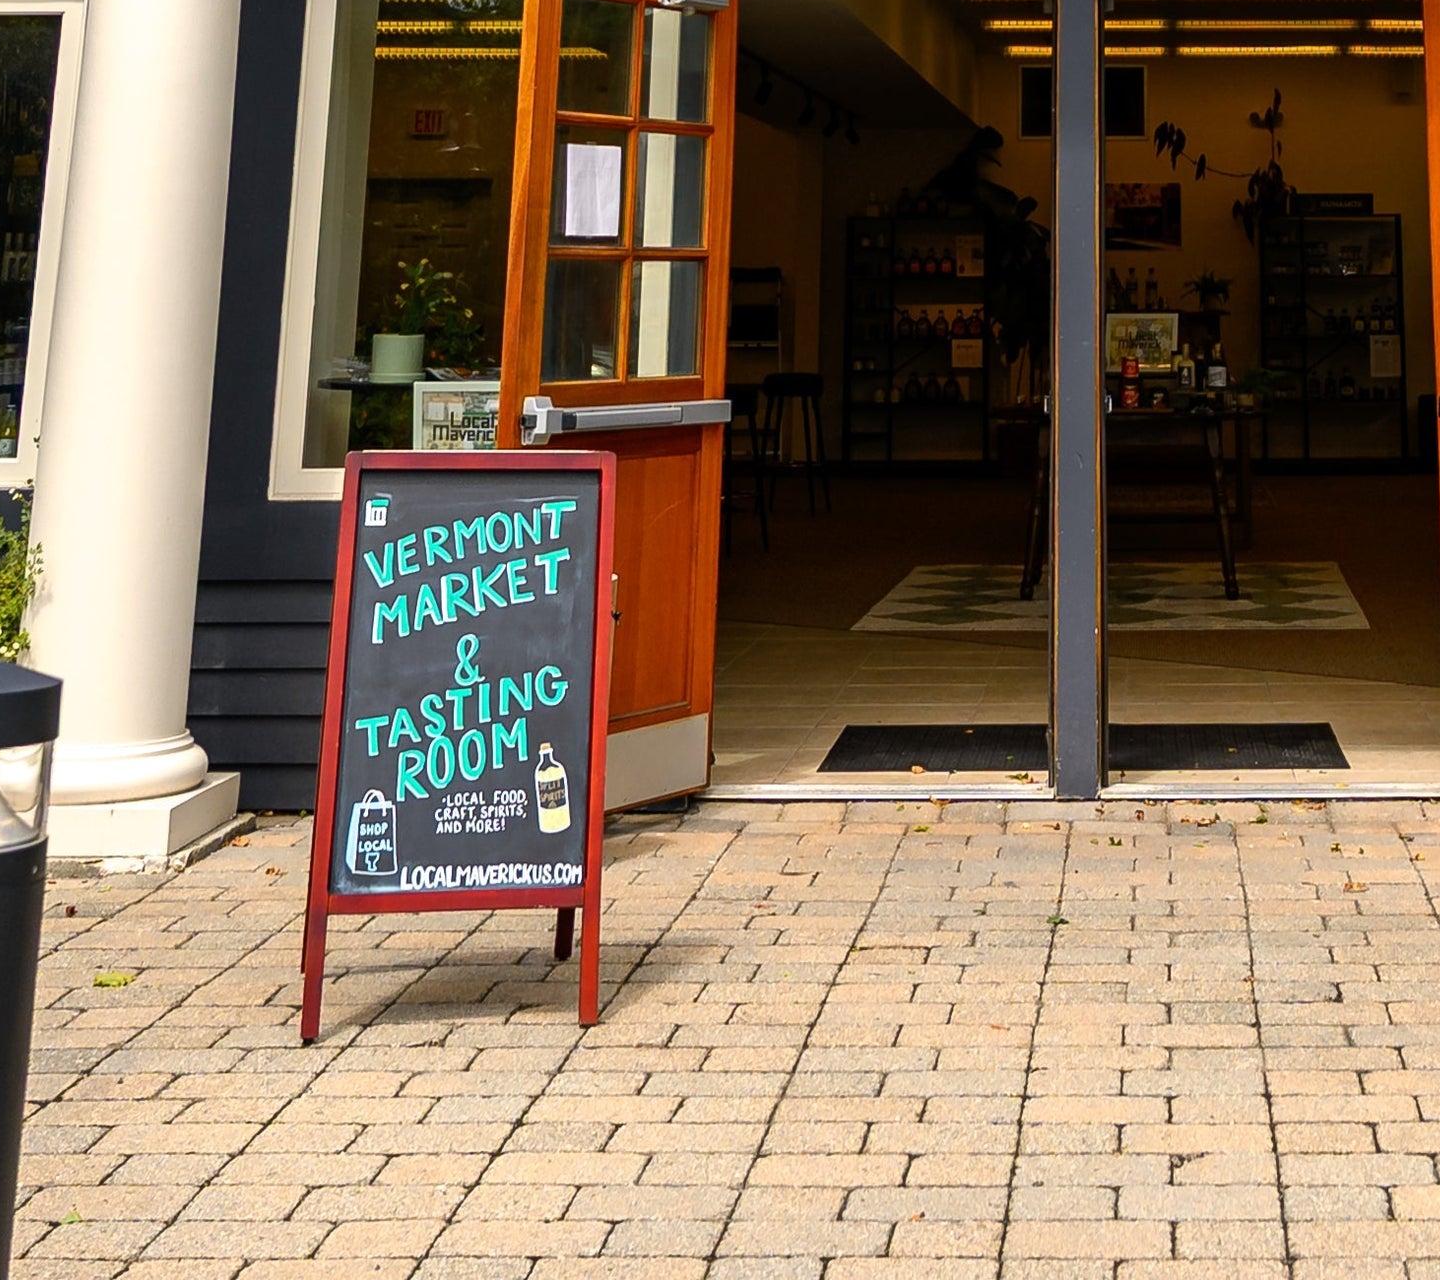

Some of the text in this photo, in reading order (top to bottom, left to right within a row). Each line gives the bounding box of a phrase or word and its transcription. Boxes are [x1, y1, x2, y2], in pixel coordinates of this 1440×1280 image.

[415, 109, 444, 133] EXIT
[450, 411, 495, 428] Local
[363, 500, 577, 588] VERMONT
[371, 547, 571, 645] MARKET
[454, 633, 486, 686] &
[354, 664, 569, 757] TASTING
[396, 717, 529, 802] ROOM
[445, 789, 529, 806] LOCAL FOOD,
[434, 804, 528, 822] CRAFT, SPIRITS,
[359, 821, 389, 836] SHOP
[435, 818, 506, 835] AND MORE!
[358, 838, 394, 853] LOCAL
[399, 862, 584, 891] LOCALMAVERICKUS.COM
